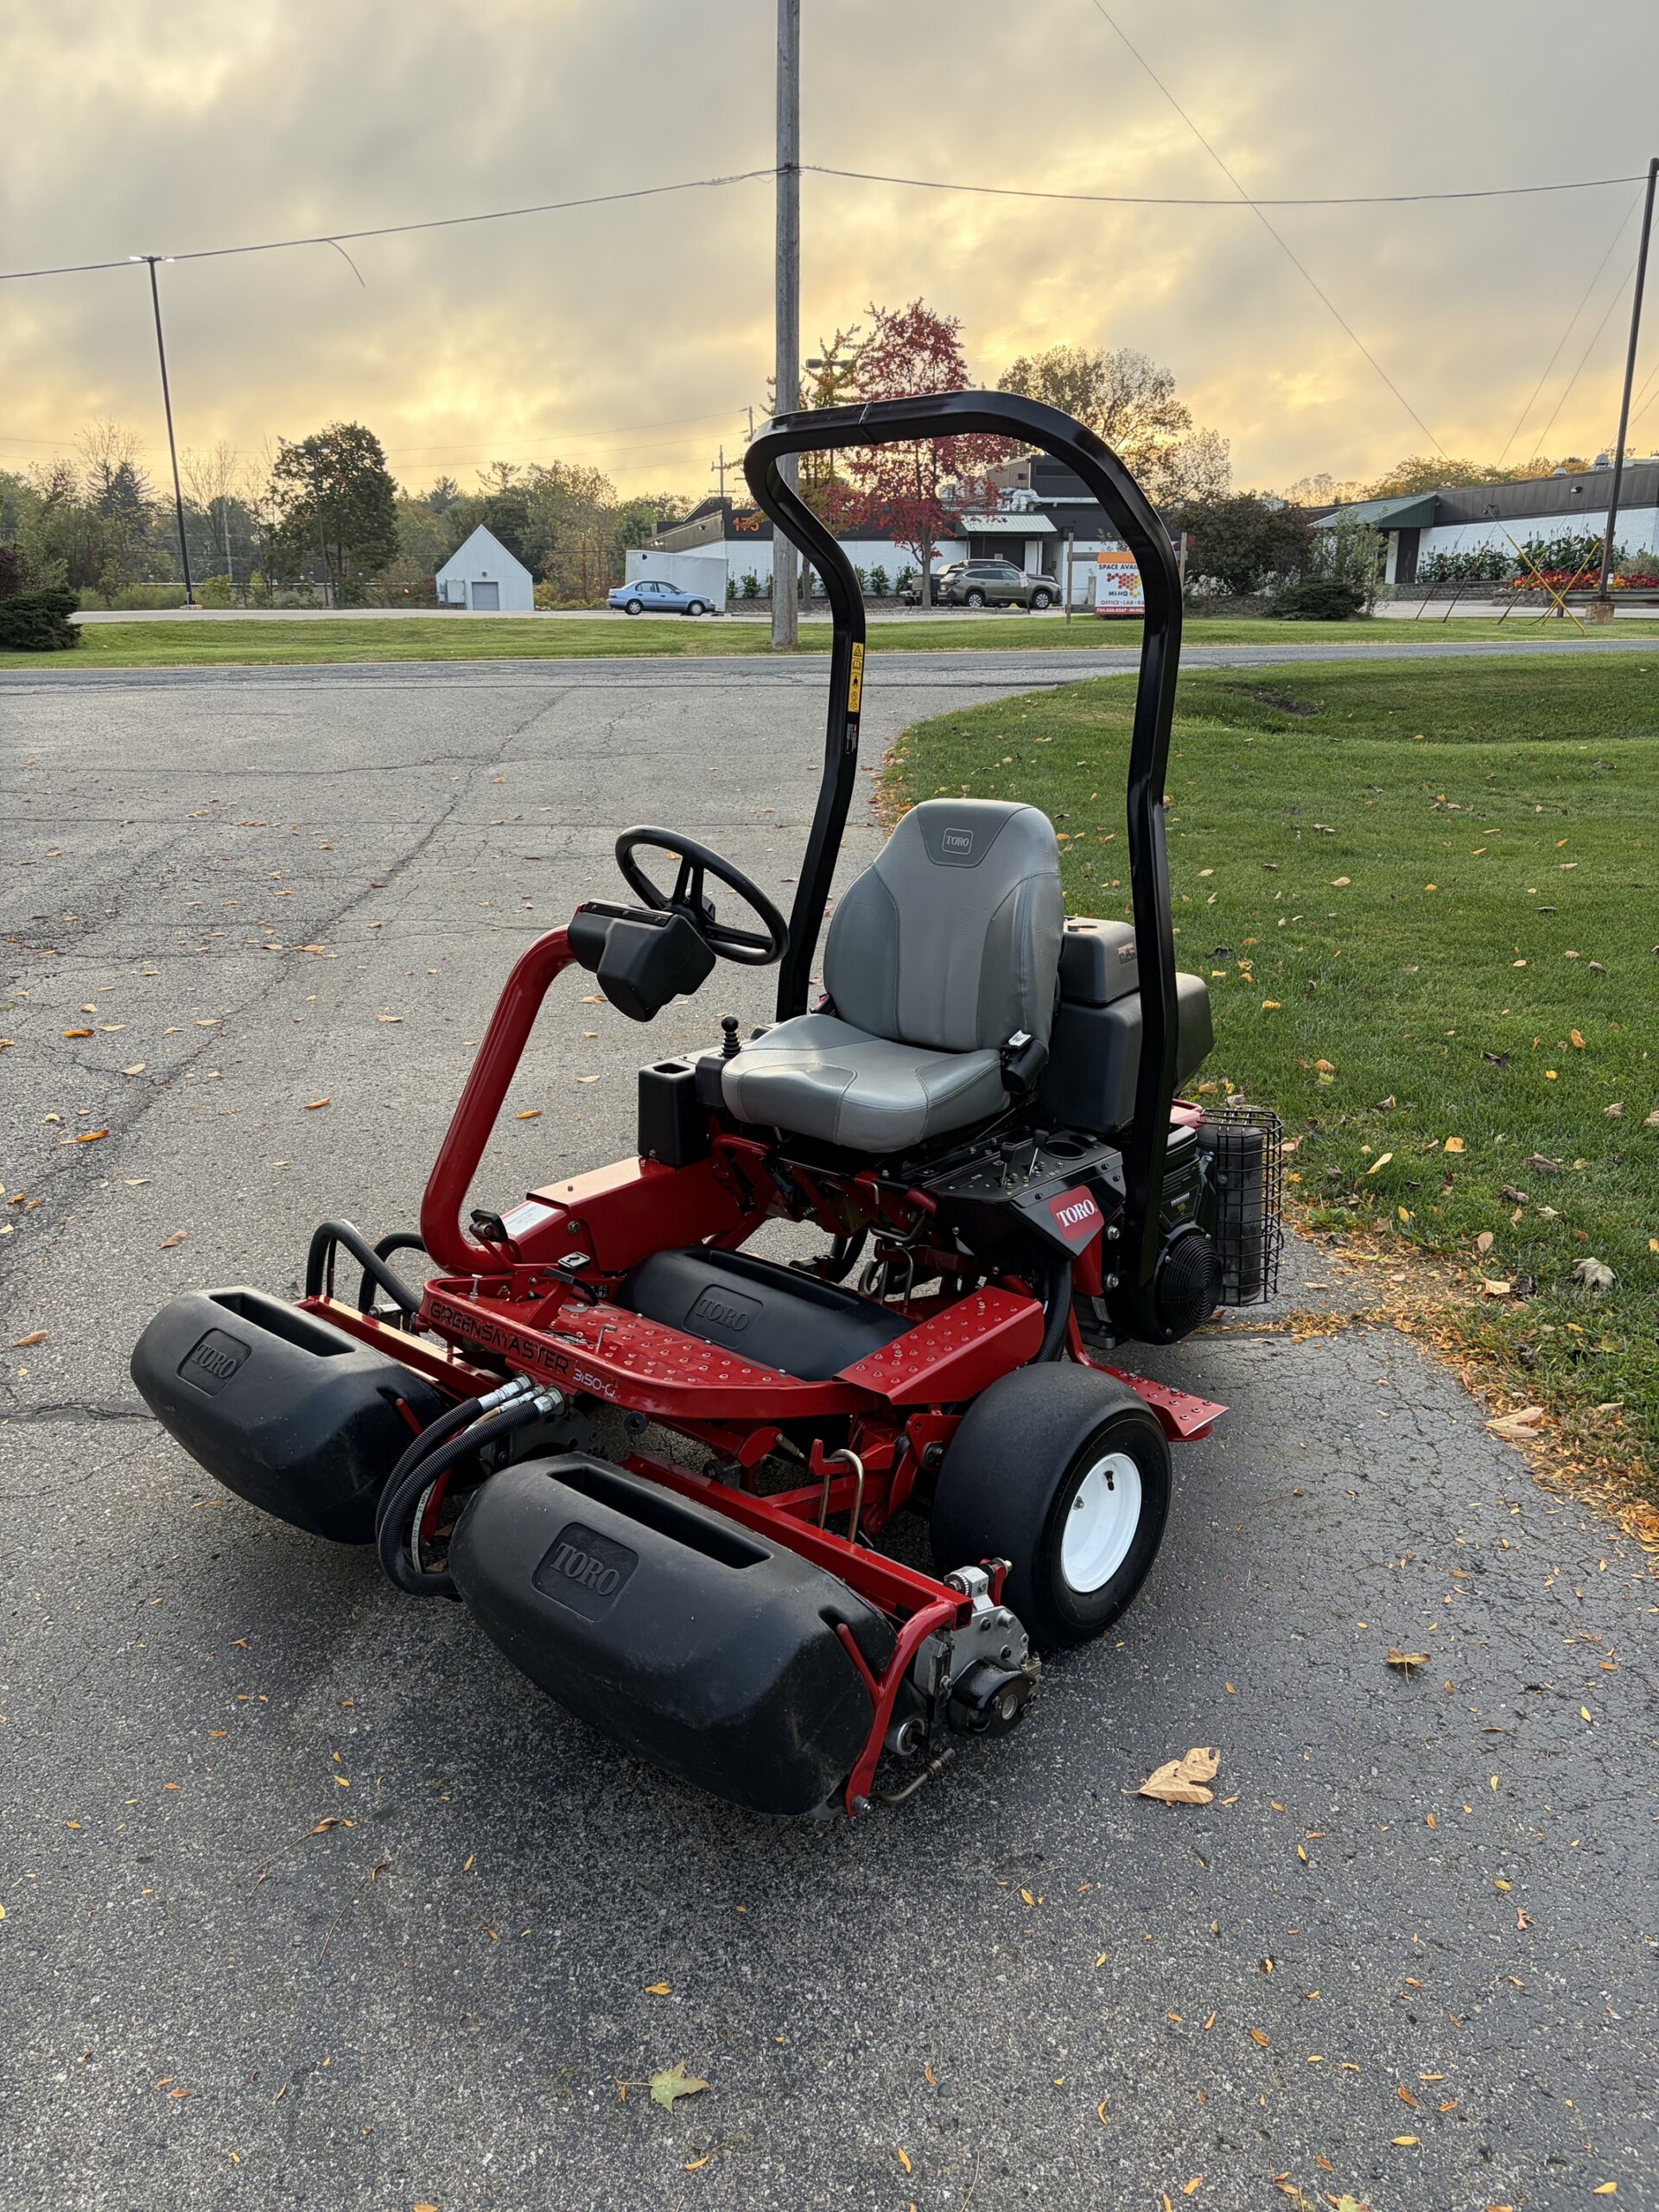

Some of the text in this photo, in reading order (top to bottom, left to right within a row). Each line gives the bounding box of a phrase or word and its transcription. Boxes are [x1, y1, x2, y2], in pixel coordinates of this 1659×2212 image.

[945, 836, 969, 847] TORO
[1056, 1199, 1095, 1227] TORO
[696, 1299, 750, 1331] TORO
[430, 1300, 569, 1375] GREENSMASTER
[192, 1344, 237, 1378] TORO
[550, 1542, 620, 1595] TORO
